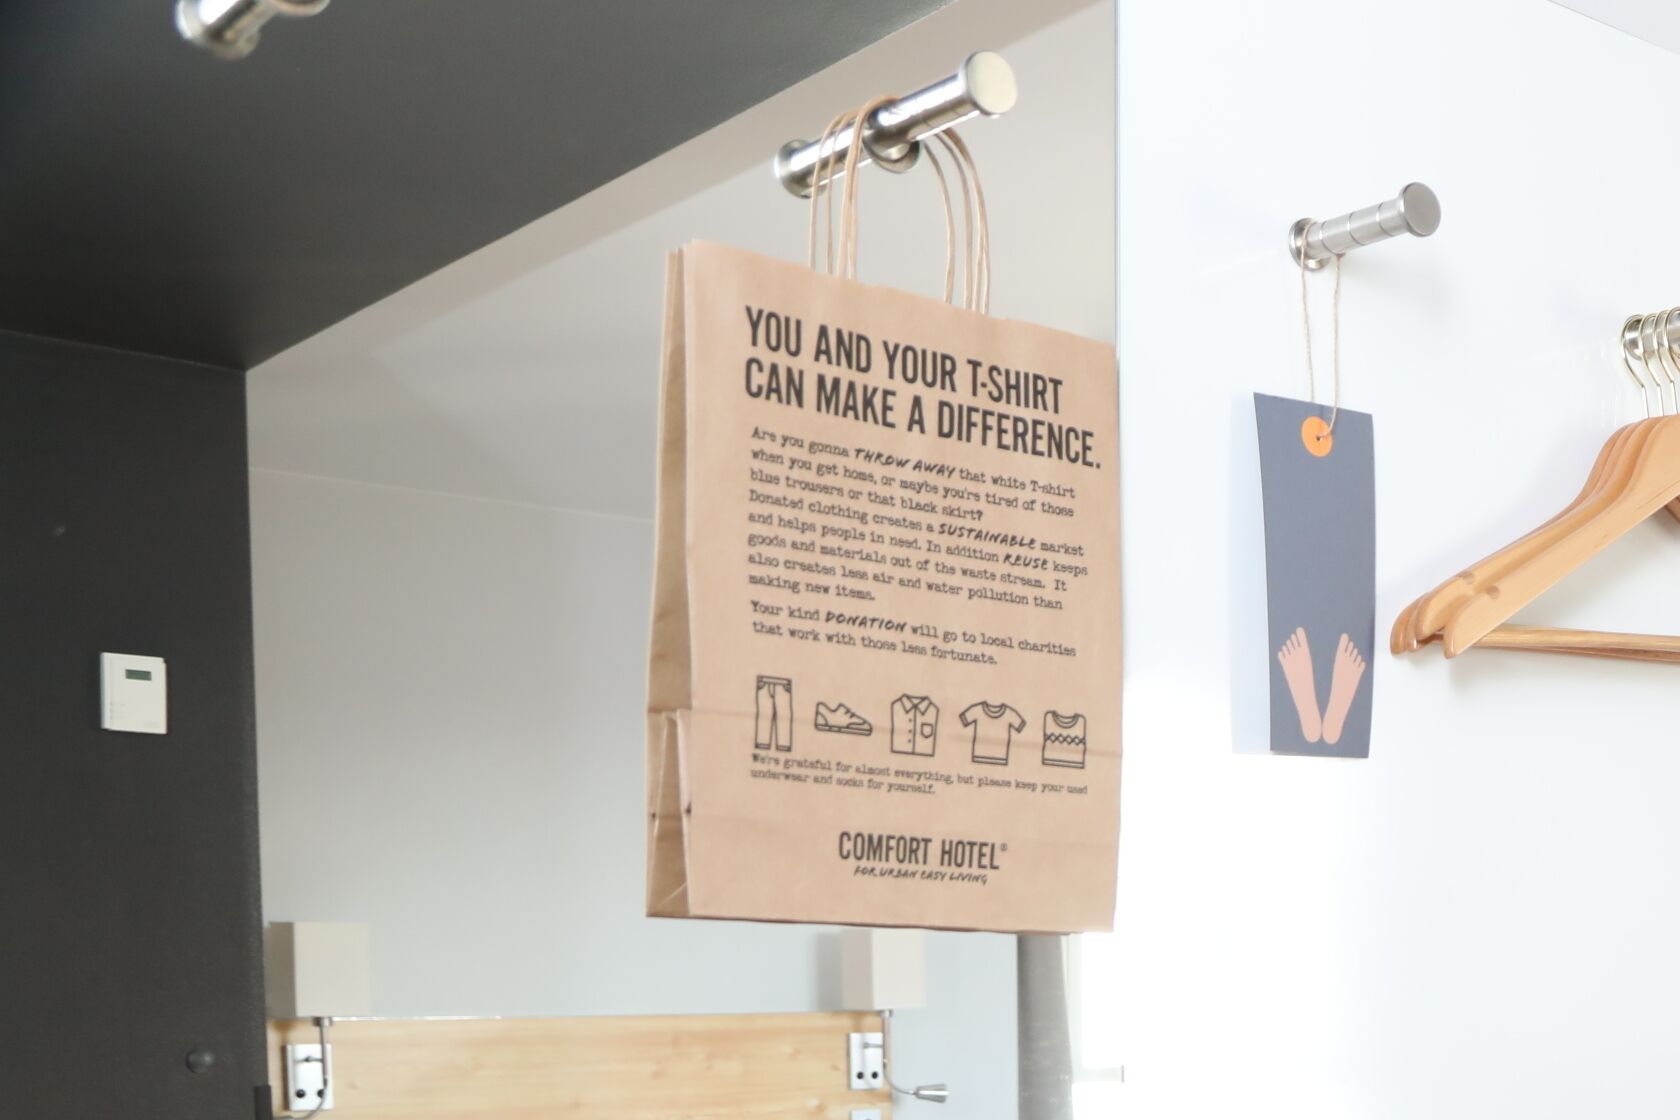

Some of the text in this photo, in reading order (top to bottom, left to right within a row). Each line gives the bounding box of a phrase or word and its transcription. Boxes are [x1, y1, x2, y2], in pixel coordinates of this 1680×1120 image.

[745, 305, 1063, 415] YOU AND YOUR T-SHIRT
[745, 357, 1102, 469] CAN MAKE A DIFFERENCE.
[752, 426, 1076, 499] Are you gonna THROW AWAY that white T-shirt
[752, 448, 1074, 518] when you get home, or maybe you're tired of those
[749, 489, 1085, 557] Donated clothing creates a SUSTAINABLE market
[750, 468, 984, 522] blue trousers or that black skirt?
[748, 511, 1088, 577] and helps people in need. In addition REUSE keeps
[748, 532, 1068, 592] goods and materials out of the waste stream. It
[748, 552, 1064, 611] also creates less air and water pollution than
[749, 573, 876, 601] making new items.
[750, 599, 1077, 658] Your kind DONATION will go to local charities
[752, 621, 998, 666] that work with those less fortunate.
[838, 831, 933, 866] COMFORT
